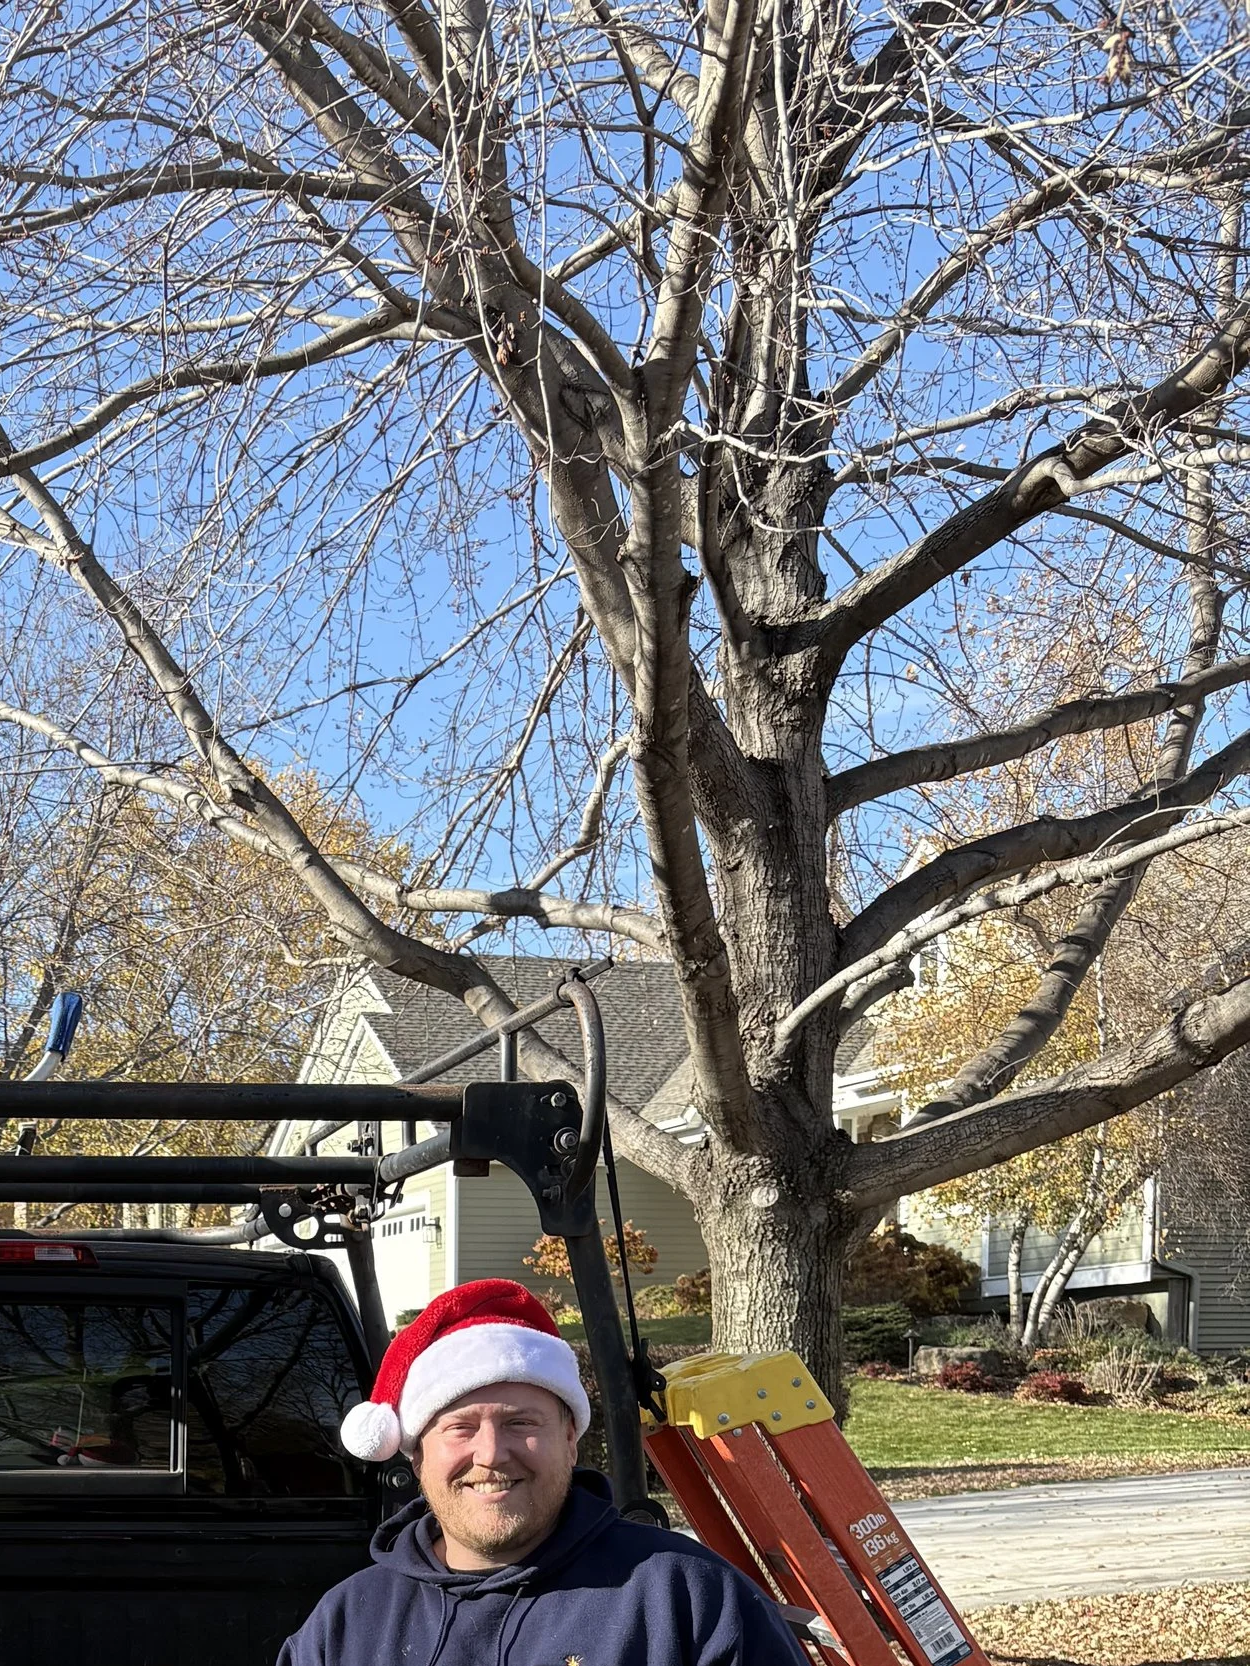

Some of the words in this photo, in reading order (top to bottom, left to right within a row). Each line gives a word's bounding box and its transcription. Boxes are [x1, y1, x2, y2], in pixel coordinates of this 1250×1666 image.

[852, 1513, 887, 1540] 300lb
[862, 1534, 887, 1558] 136
[886, 1531, 900, 1545] kg
